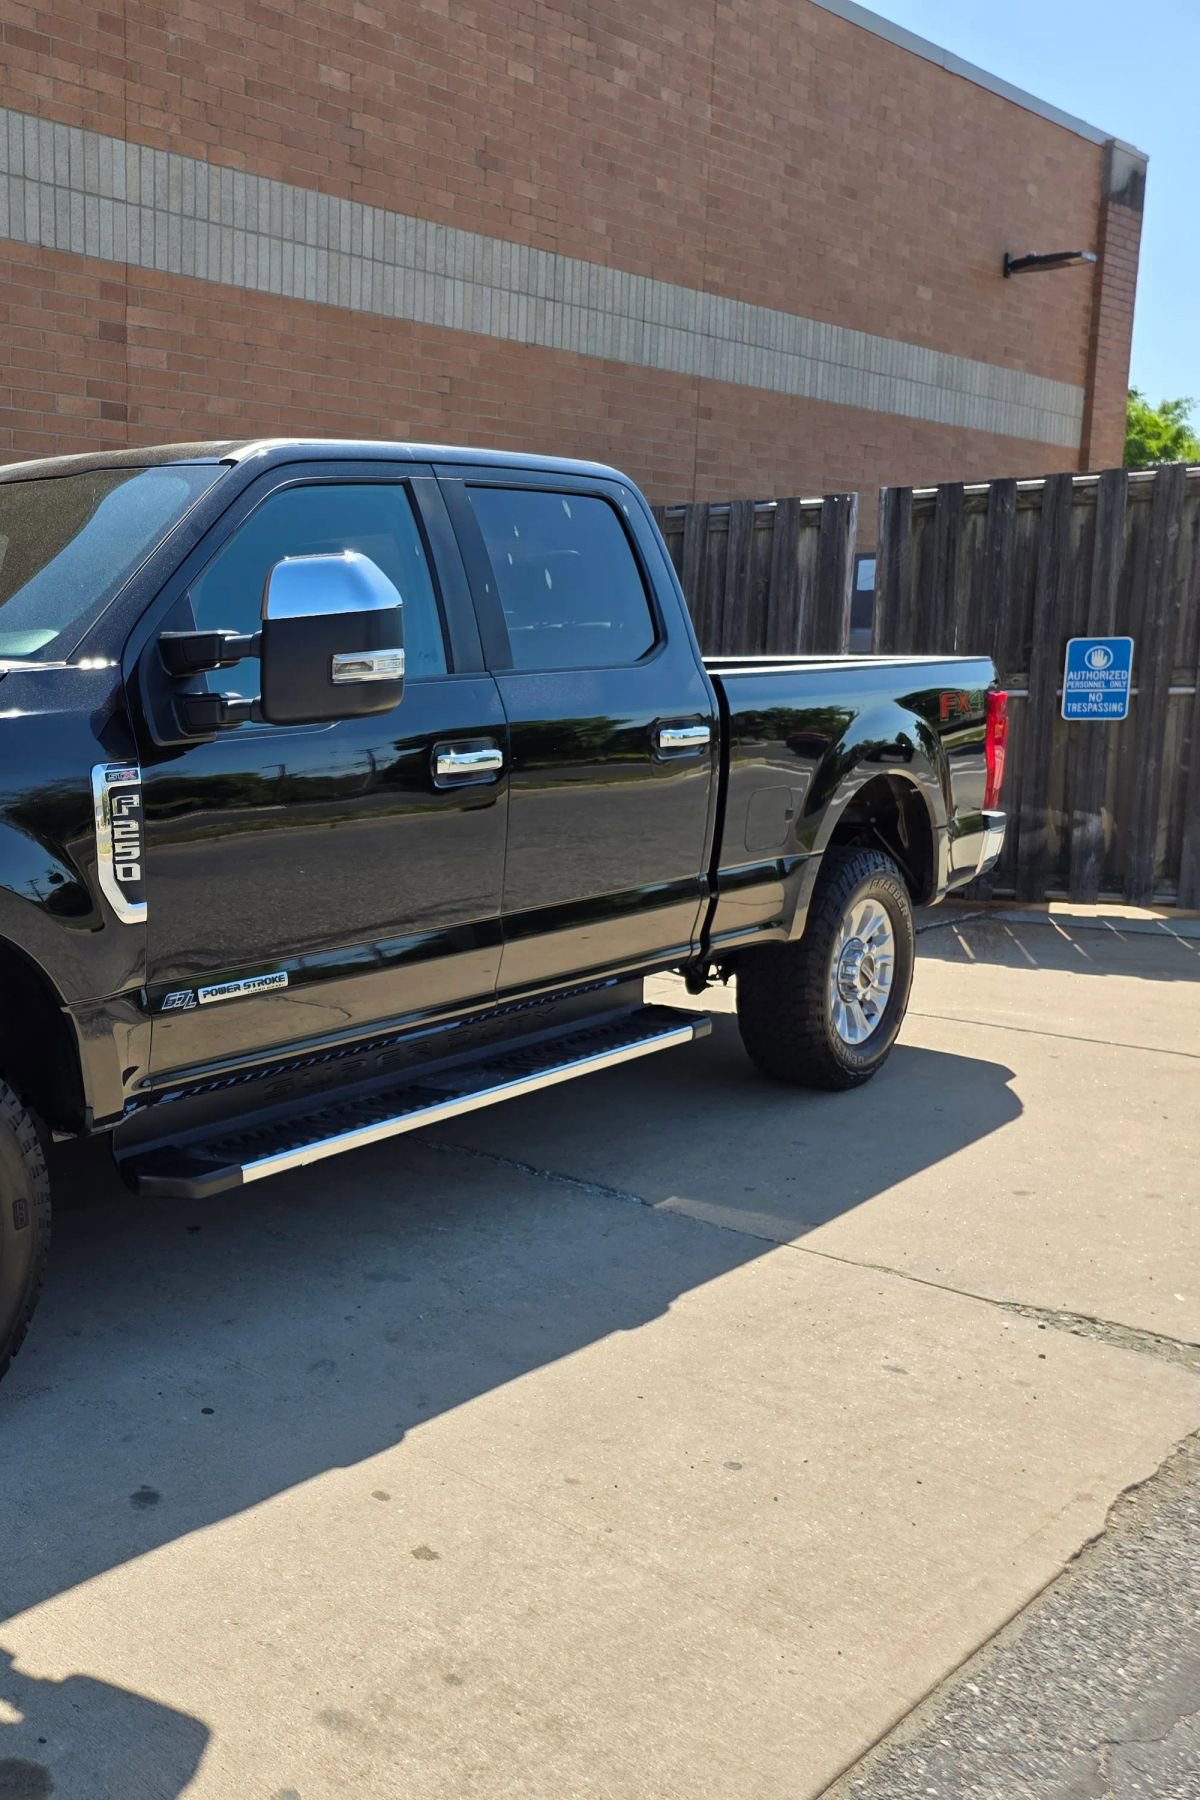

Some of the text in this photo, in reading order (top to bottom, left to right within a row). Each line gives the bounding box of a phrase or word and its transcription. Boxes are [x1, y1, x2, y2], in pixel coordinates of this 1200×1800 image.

[1068, 670, 1128, 681] AUTHORIZED
[1066, 680, 1127, 689] PERSONNEL ONLY
[1088, 692, 1103, 703] NO
[940, 689, 984, 721] FX4
[1067, 702, 1124, 713] TRESPASSING
[107, 769, 137, 781] STX
[112, 793, 141, 882] F250
[869, 879, 909, 917] GRABBER
[161, 989, 198, 1010] 6.7L
[202, 982, 242, 999] POWER
[242, 973, 287, 990] STROKE
